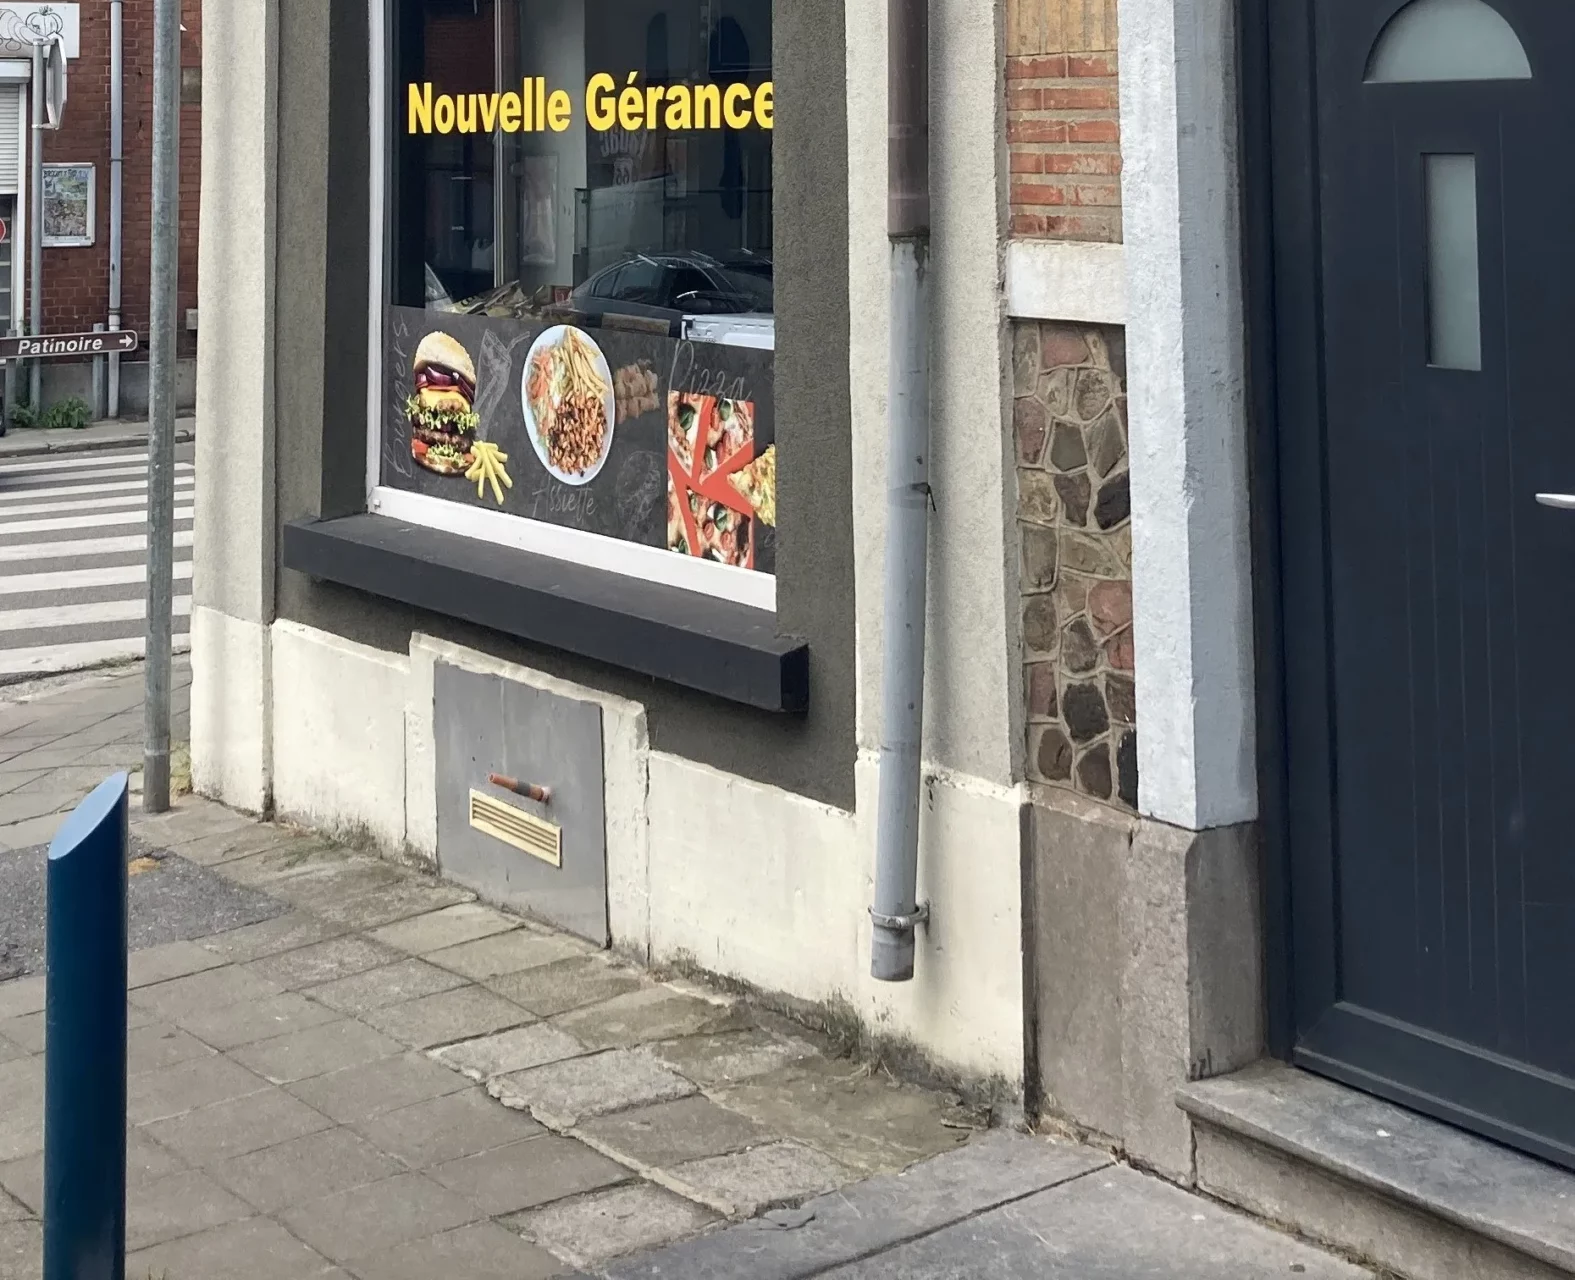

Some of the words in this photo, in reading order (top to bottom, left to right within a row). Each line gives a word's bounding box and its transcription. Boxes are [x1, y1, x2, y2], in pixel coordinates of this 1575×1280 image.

[407, 76, 572, 135] Nouvelle
[585, 70, 774, 133] Gérance
[18, 336, 103, 355] Patinoire
[668, 339, 753, 404] Pizza
[532, 473, 598, 525] Assiette
